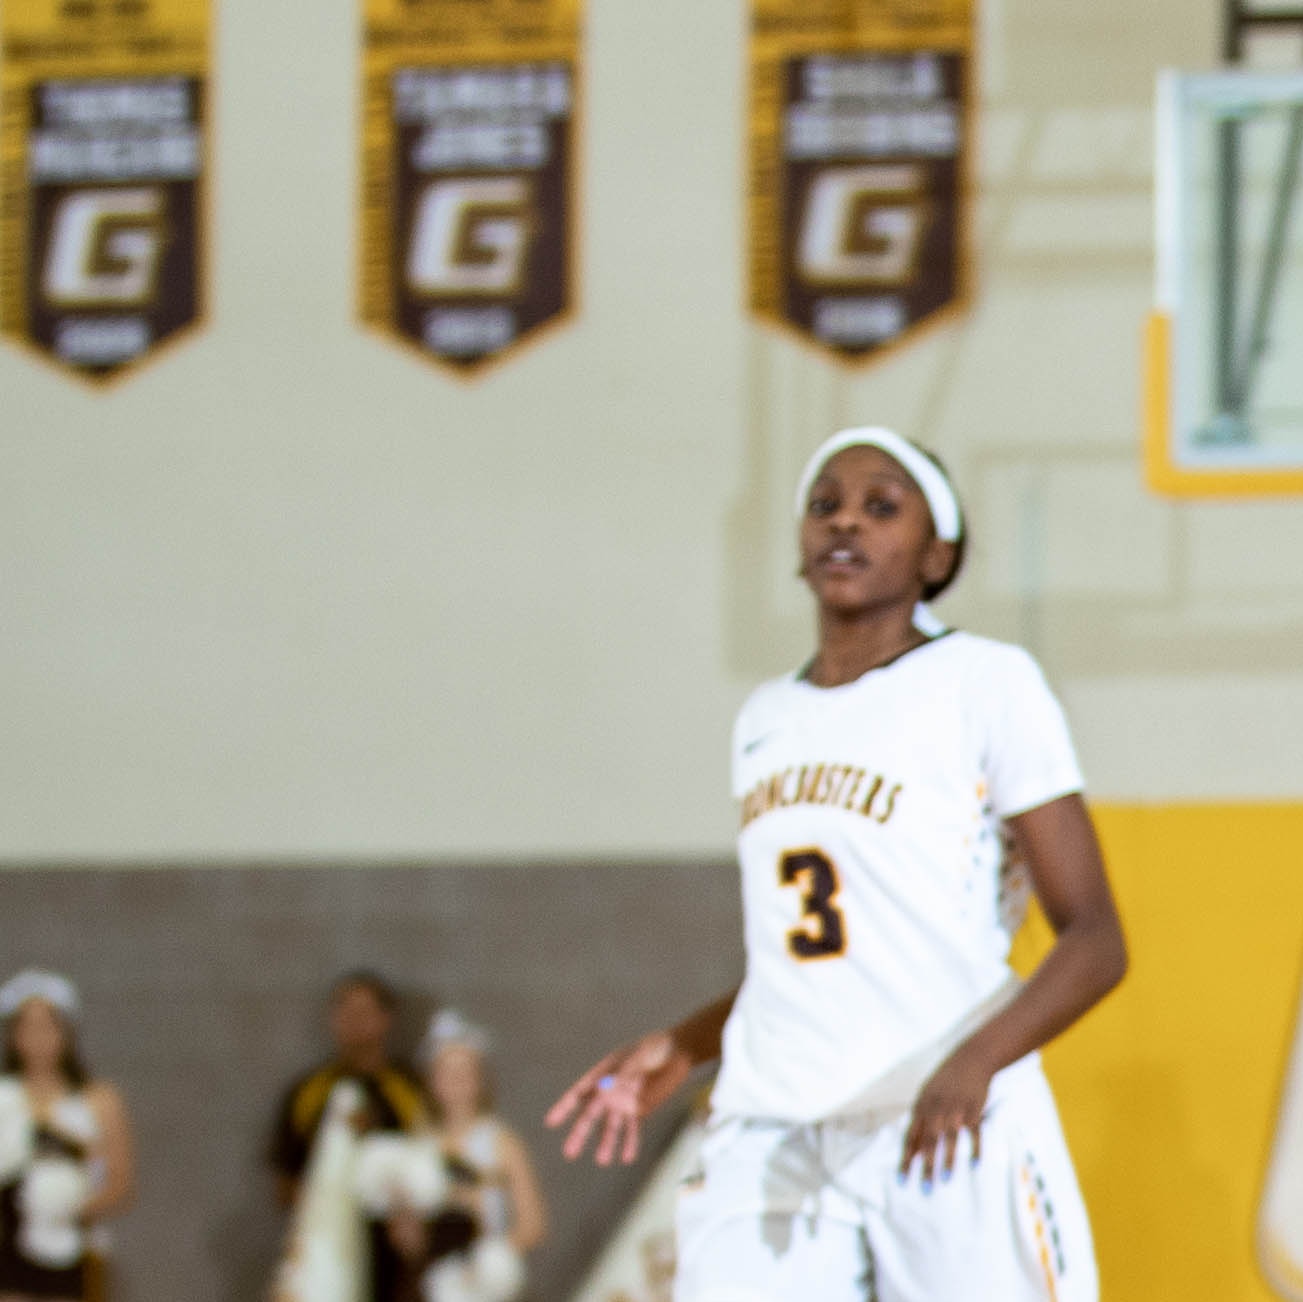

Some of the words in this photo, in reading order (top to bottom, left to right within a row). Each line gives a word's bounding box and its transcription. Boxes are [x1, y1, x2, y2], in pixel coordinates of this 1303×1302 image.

[43, 186, 166, 308] G
[405, 175, 534, 298] G
[797, 164, 922, 287] G
[778, 845, 849, 963] 3
